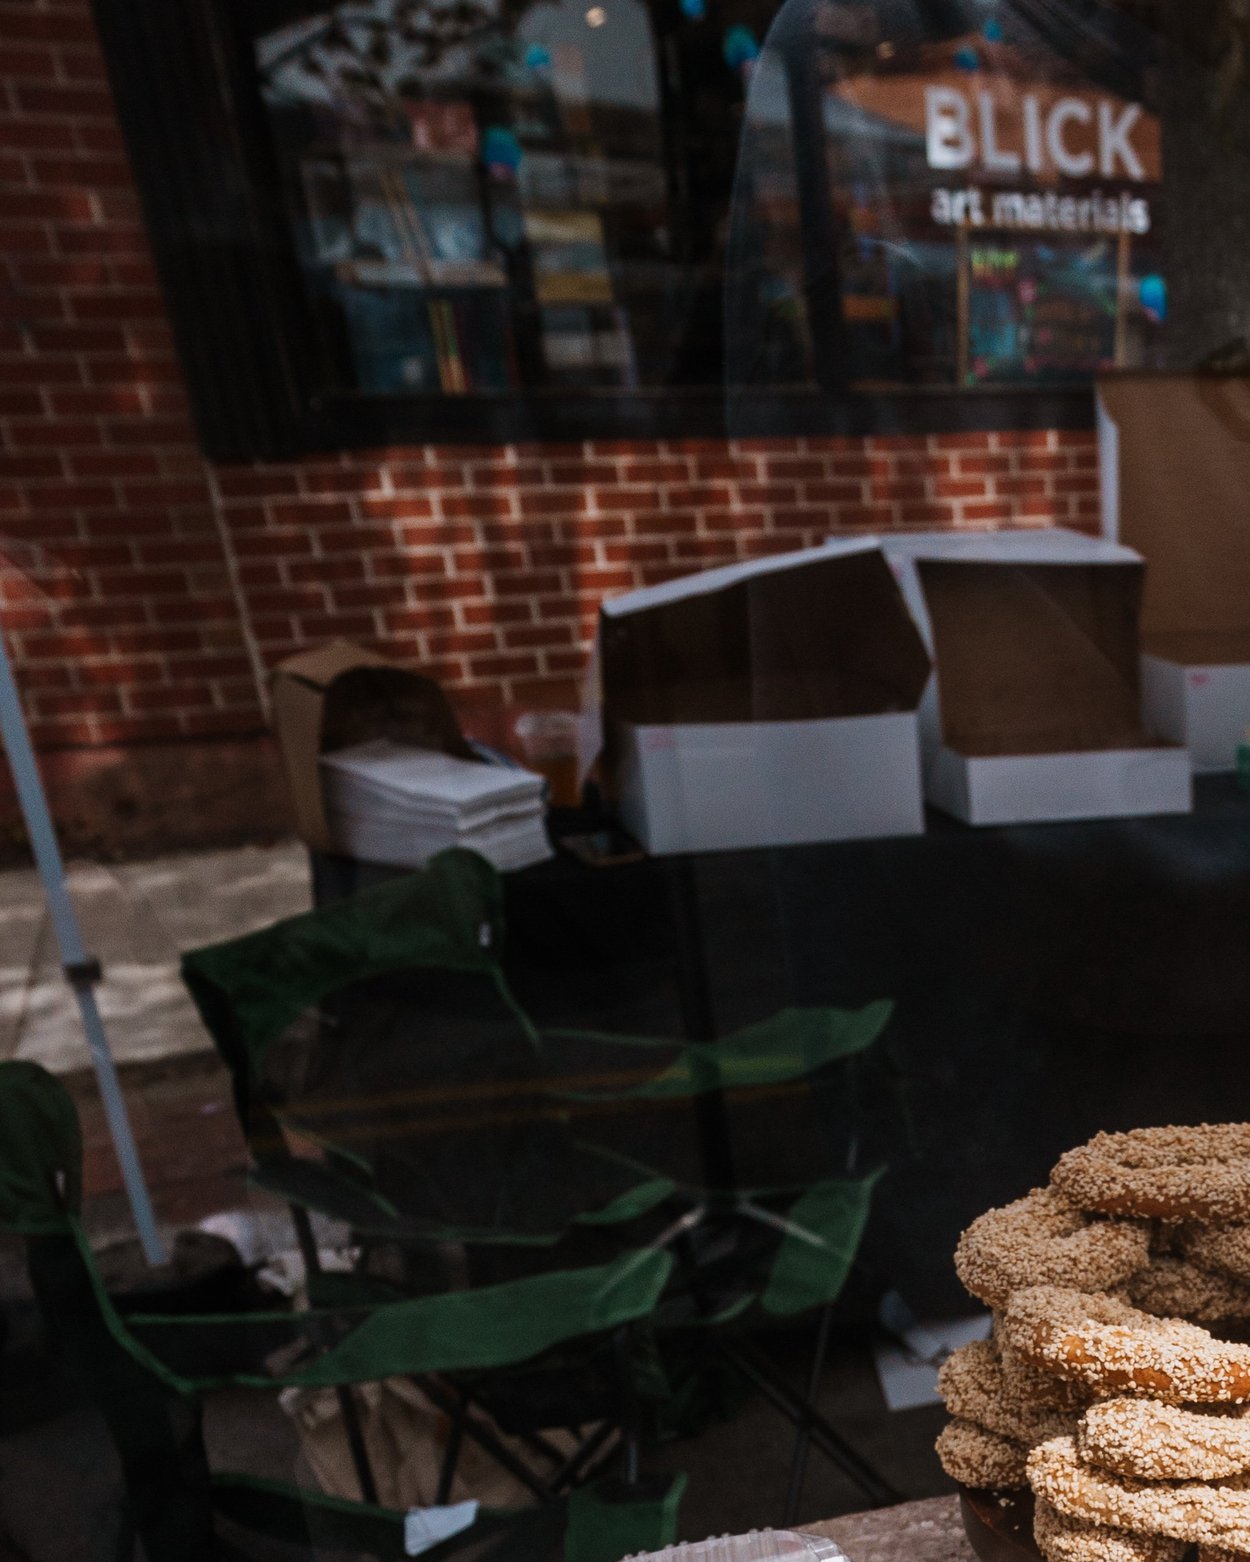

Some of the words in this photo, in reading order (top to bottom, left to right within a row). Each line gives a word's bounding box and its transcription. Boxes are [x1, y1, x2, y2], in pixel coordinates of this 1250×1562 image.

[924, 85, 1146, 180] BLICK
[930, 185, 985, 226] art
[992, 186, 1151, 235] materials
